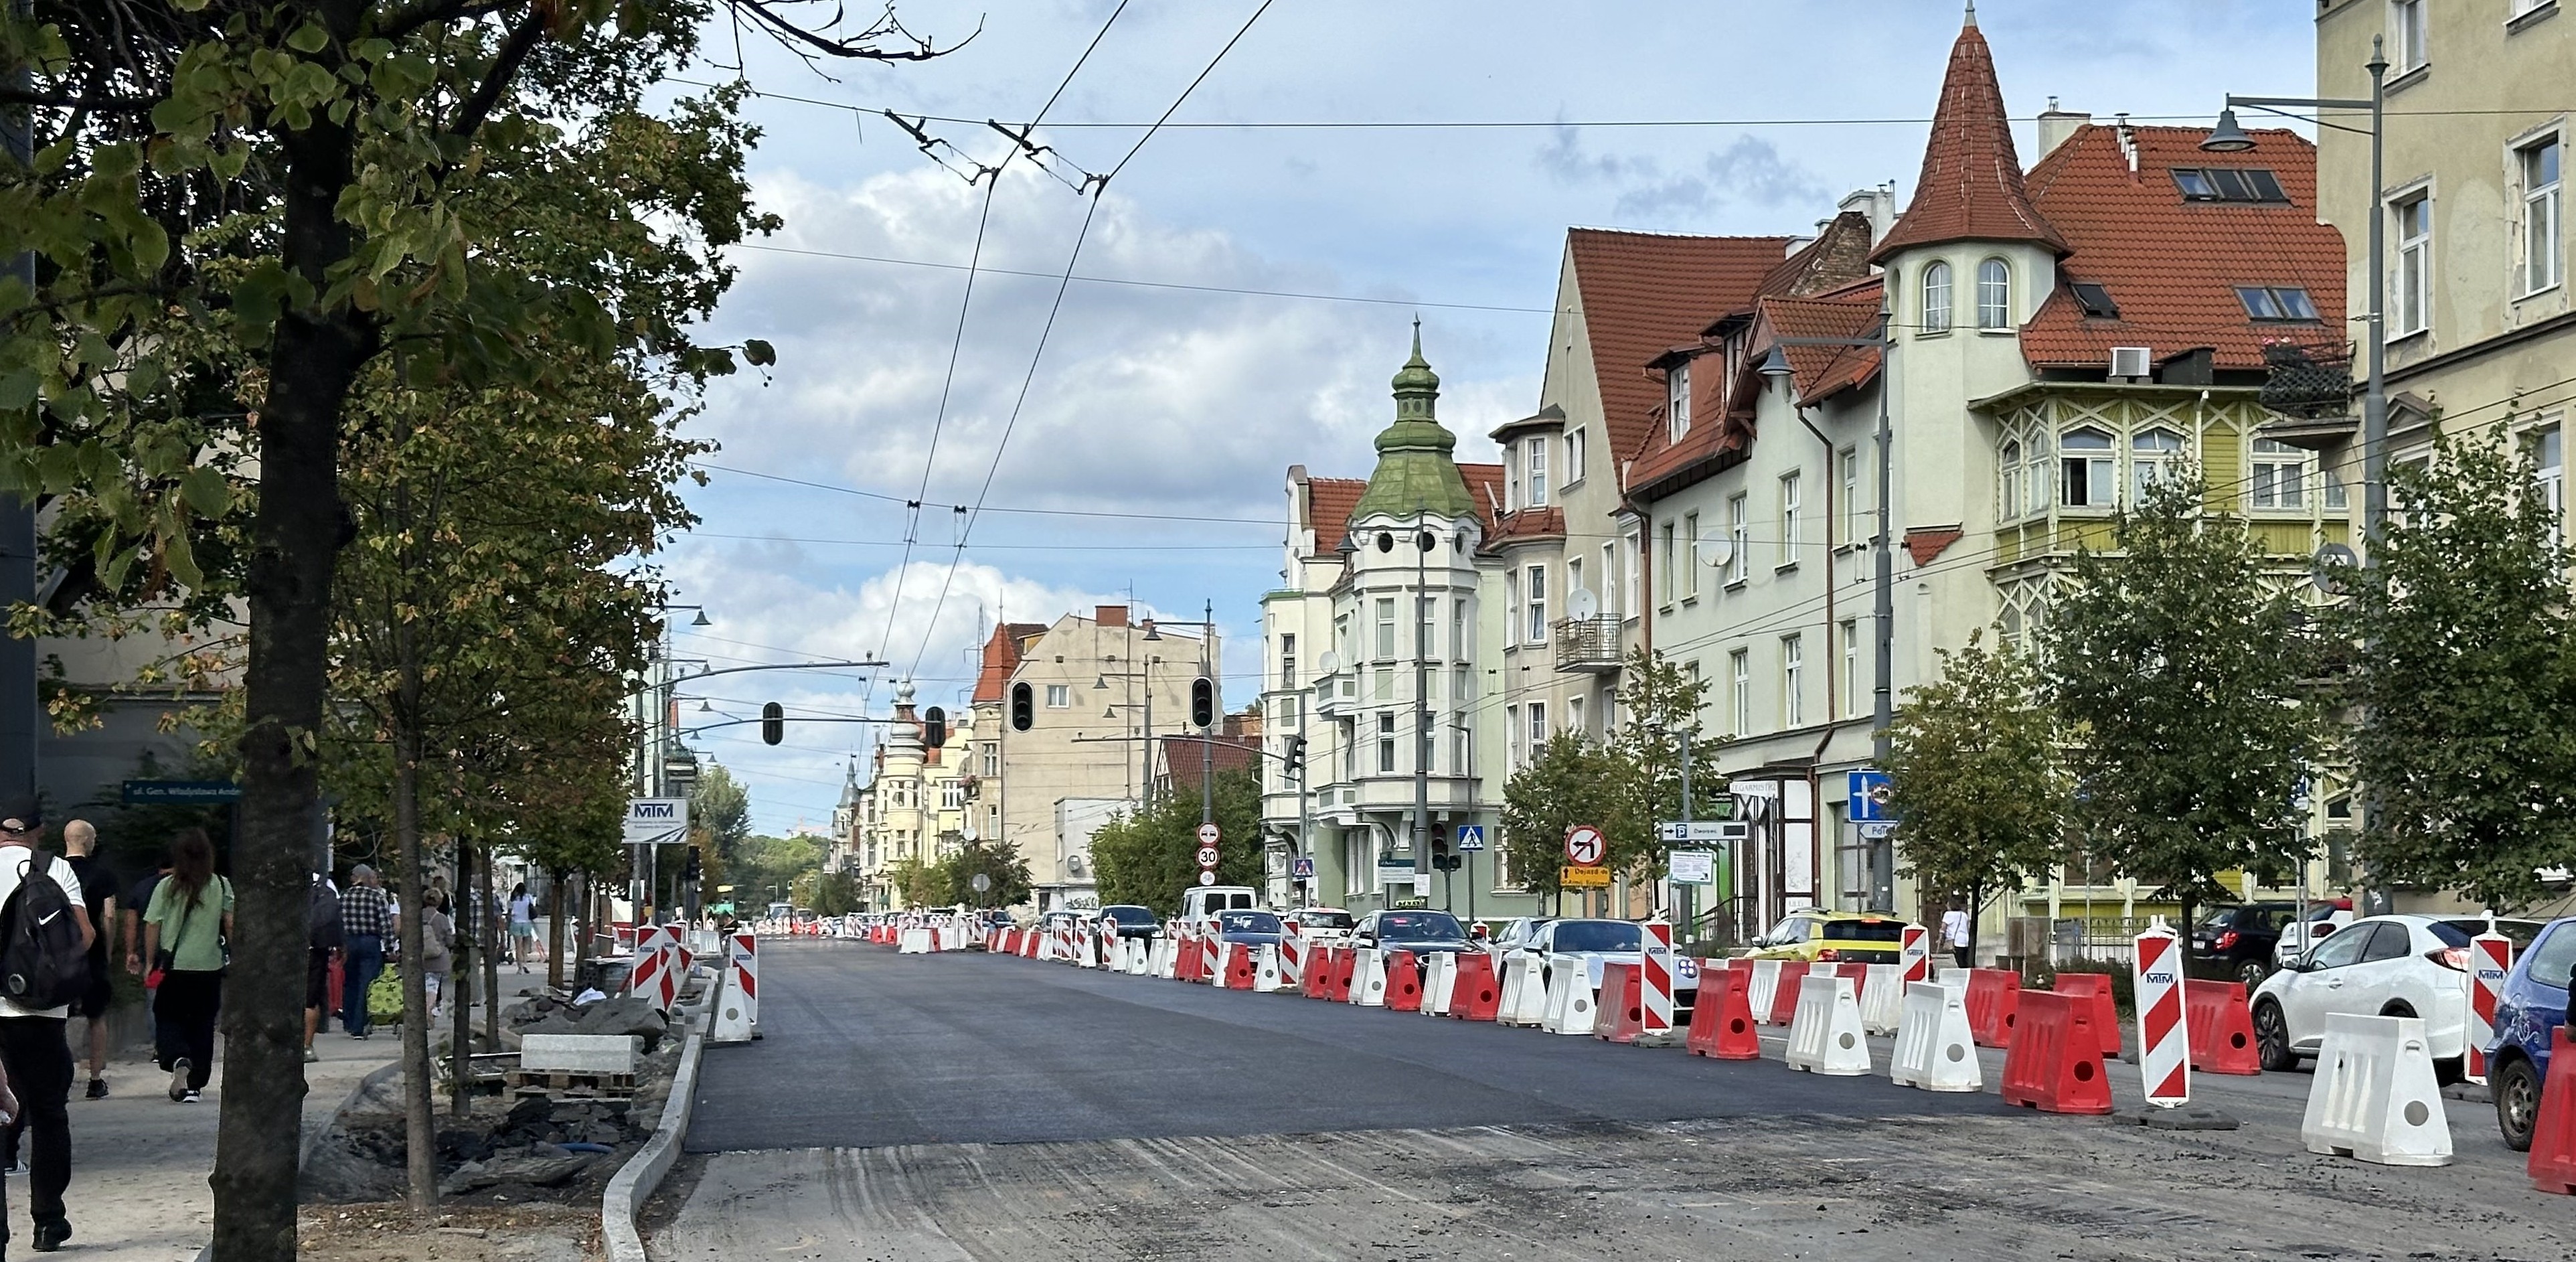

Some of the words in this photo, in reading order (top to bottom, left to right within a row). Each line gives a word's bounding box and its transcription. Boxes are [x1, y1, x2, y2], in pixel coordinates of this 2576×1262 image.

[133, 787, 145, 795] ul.
[146, 787, 167, 795] Gen.
[634, 803, 673, 817] MTM
[1201, 851, 1216, 862] 30
[2146, 973, 2173, 983] MTM
[2478, 969, 2503, 979] MTM
